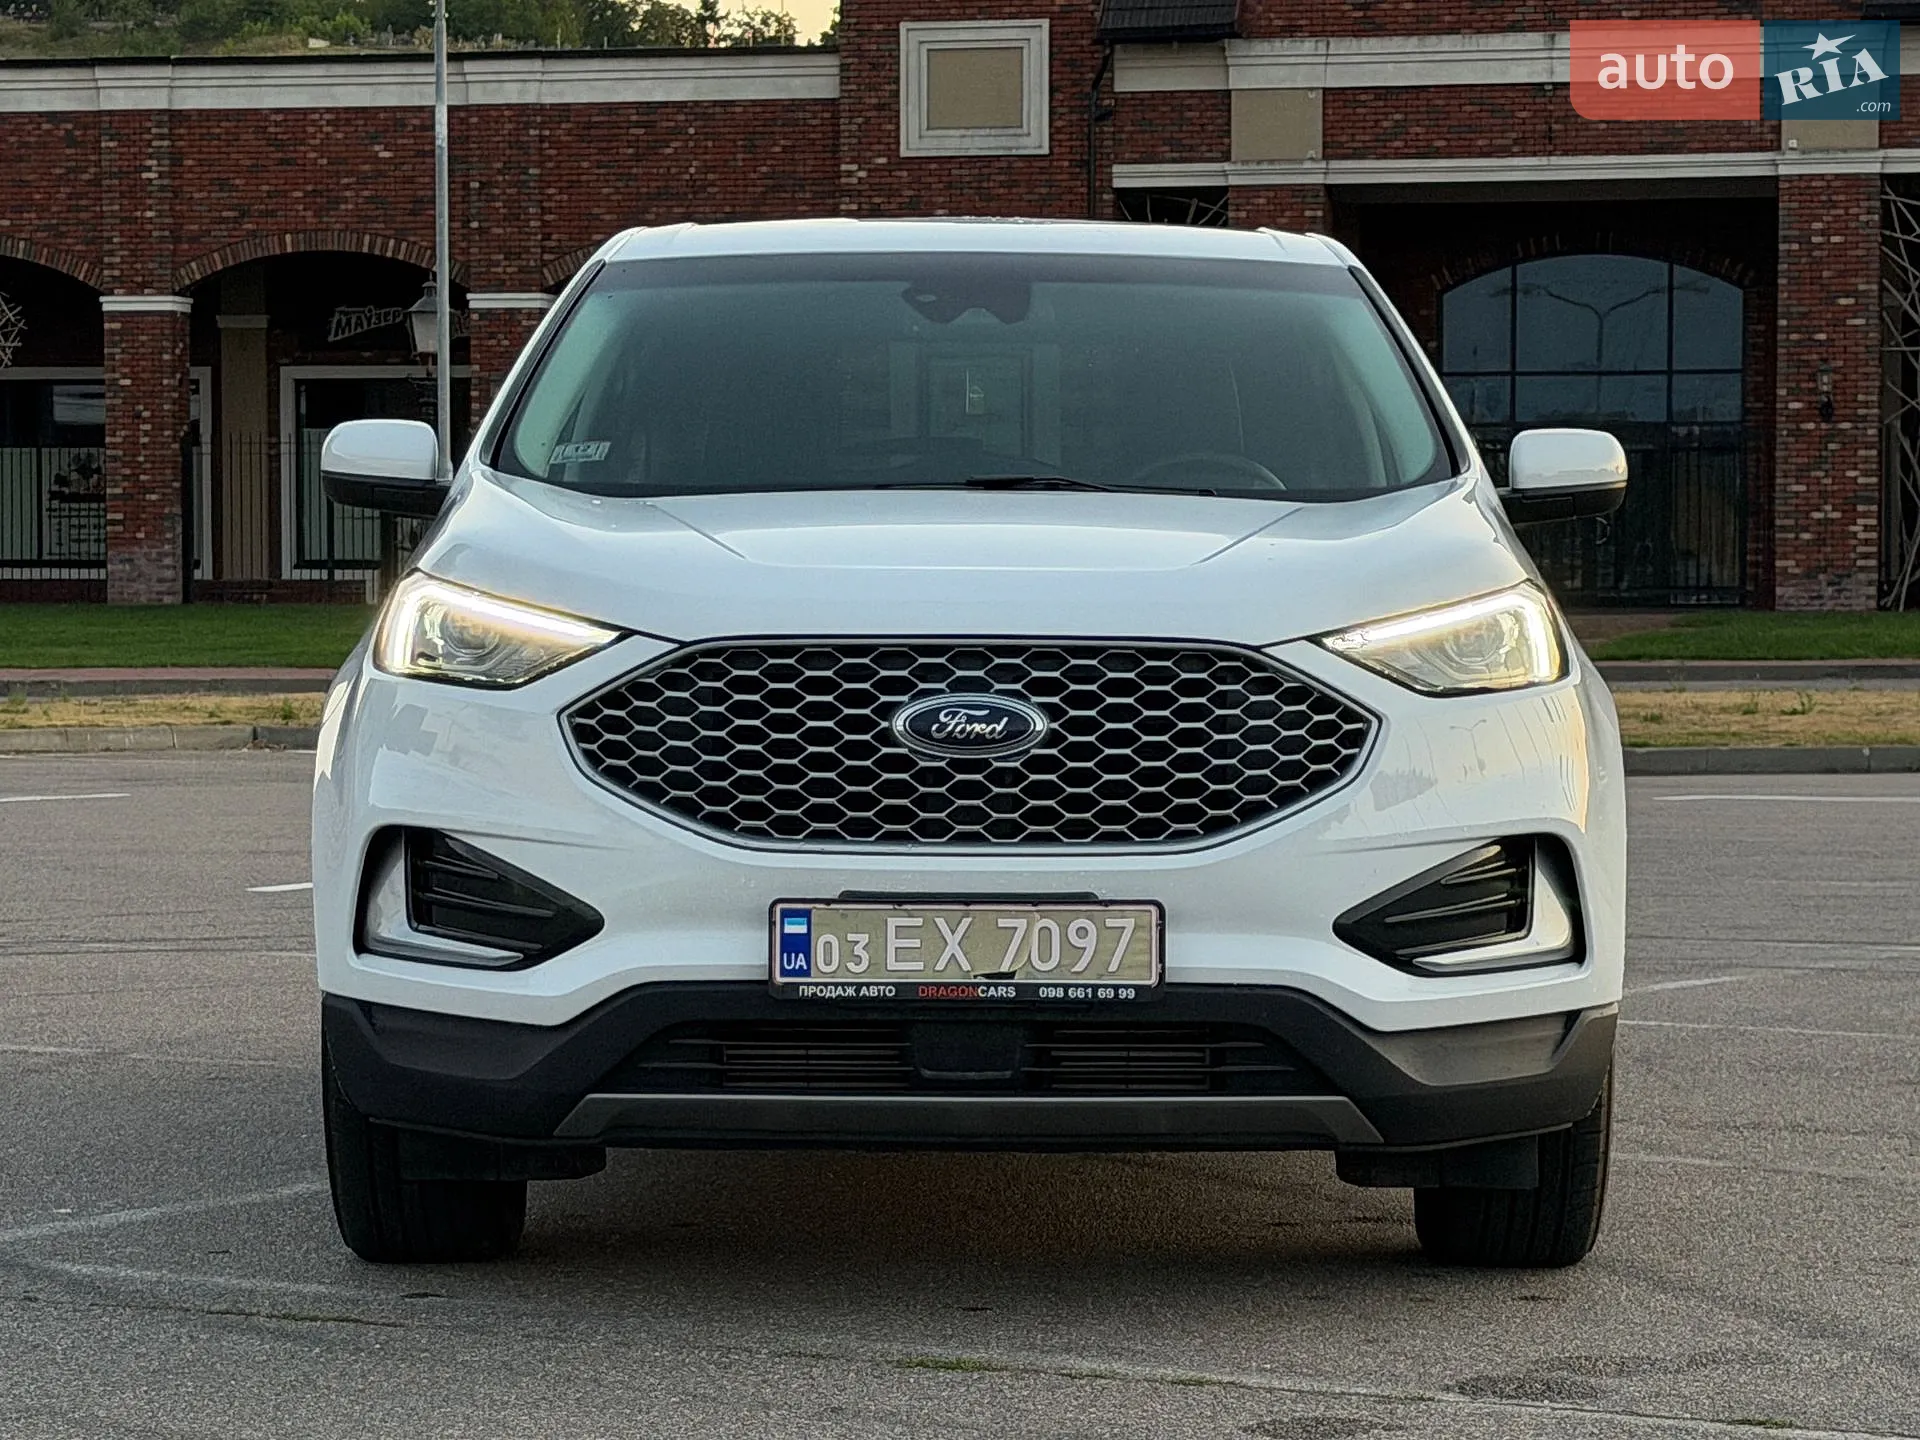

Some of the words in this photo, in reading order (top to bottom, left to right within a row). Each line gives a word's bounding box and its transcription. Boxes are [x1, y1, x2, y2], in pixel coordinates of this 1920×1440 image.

[931, 708, 1009, 740] Ford
[815, 933, 870, 974] 03
[886, 917, 973, 972] EX
[997, 917, 1136, 973] 7097
[783, 953, 808, 970] UA
[798, 985, 857, 1000] ПРОДАЖ
[859, 986, 896, 998] АВТО
[1039, 986, 1065, 999] 098
[1068, 987, 1095, 999] 661
[1097, 987, 1115, 1000] 69
[1117, 987, 1136, 1000] 99
